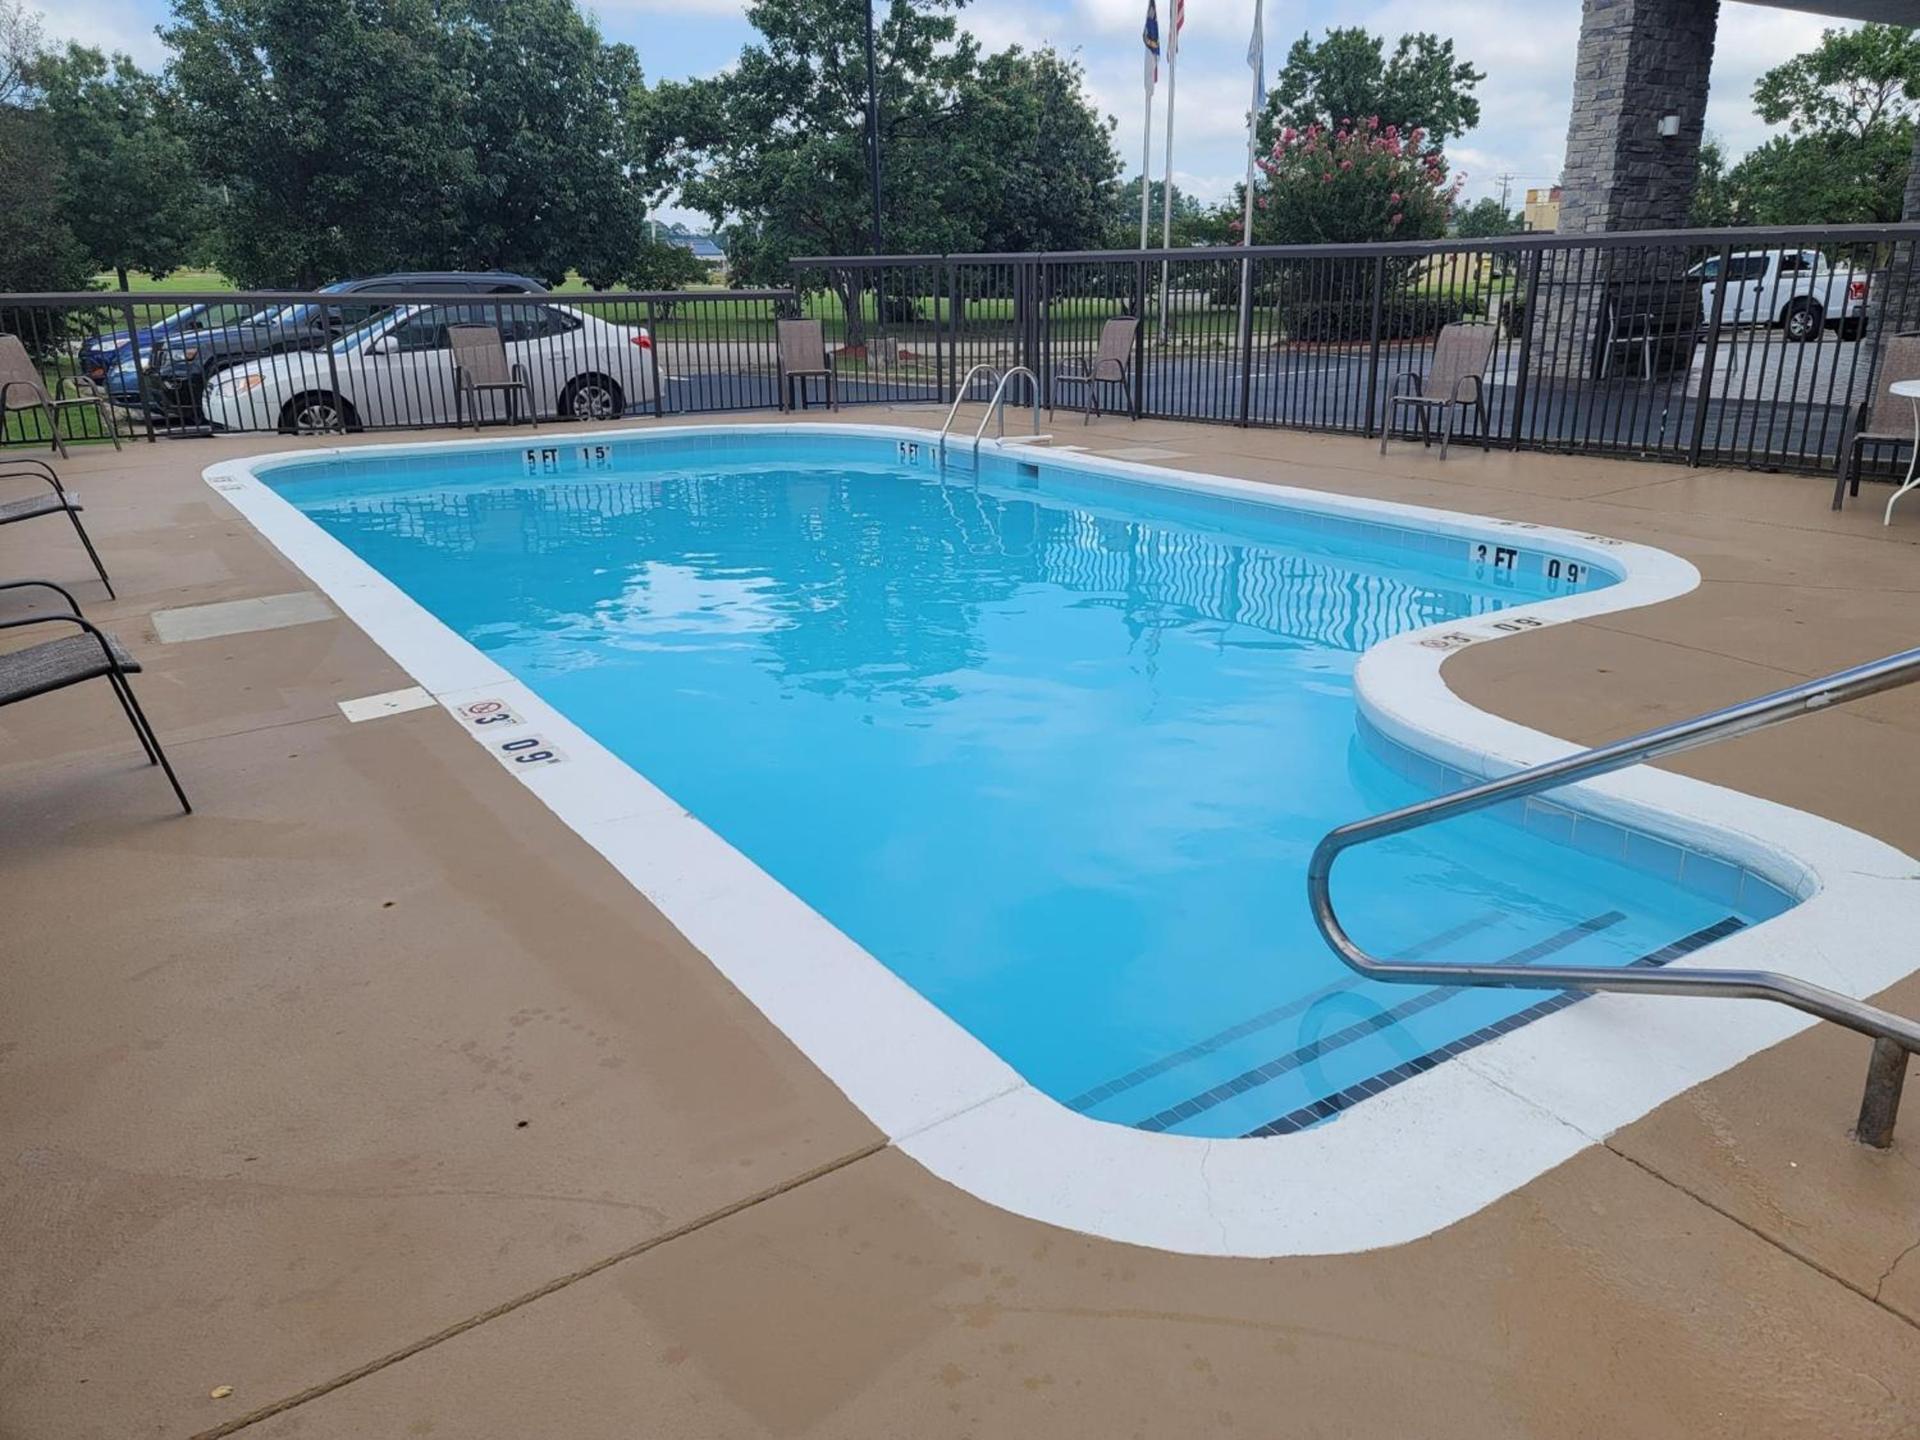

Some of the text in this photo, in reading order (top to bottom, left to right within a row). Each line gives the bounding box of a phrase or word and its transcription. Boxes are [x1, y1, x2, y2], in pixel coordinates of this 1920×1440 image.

[527, 449, 536, 464] 5
[542, 448, 557, 463] FT
[1477, 545, 1487, 563] 3
[1495, 547, 1518, 570] FT
[475, 713, 510, 725] 3
